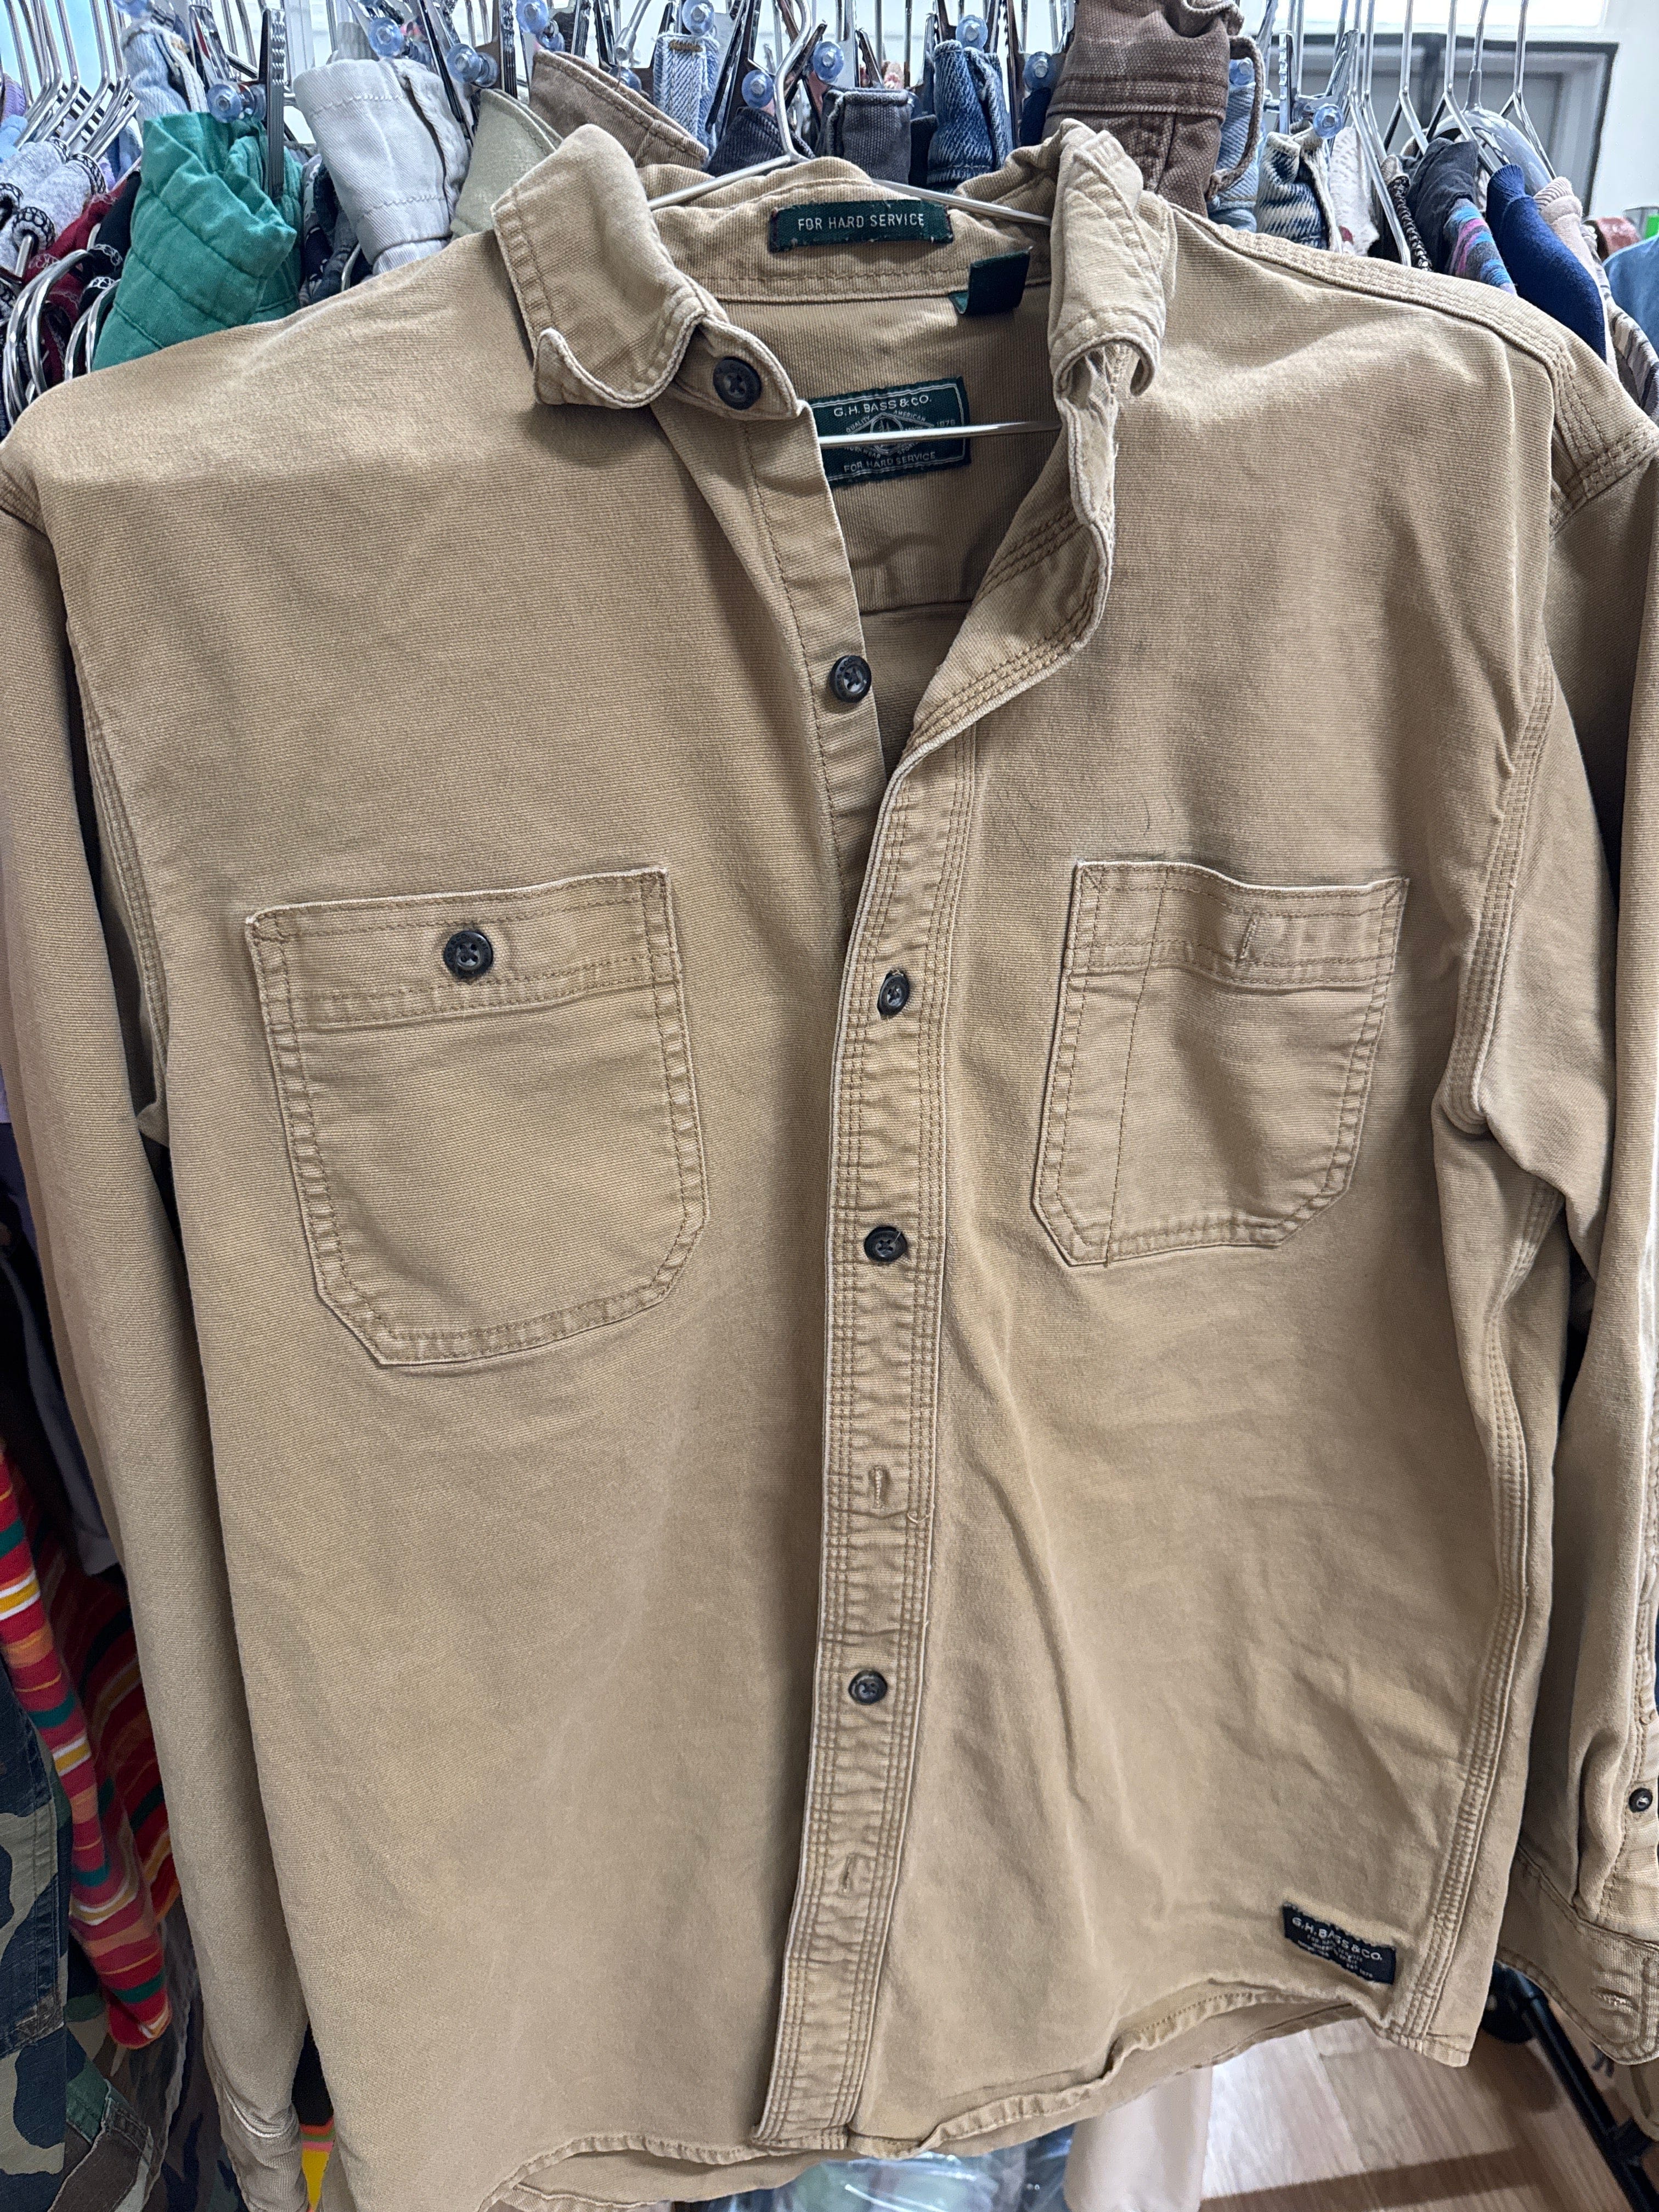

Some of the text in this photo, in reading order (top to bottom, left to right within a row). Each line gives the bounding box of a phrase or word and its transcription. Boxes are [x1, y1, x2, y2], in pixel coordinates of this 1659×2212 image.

[798, 213, 925, 231] FOR HARD SERVICE
[834, 405, 860, 416] G.H.
[863, 400, 896, 413] BASS
[893, 410, 926, 422] AMERICAN
[845, 415, 870, 433] QUALITY
[844, 452, 935, 472] FOR HARD SERVICE
[1318, 1928, 1349, 1949] BASS
